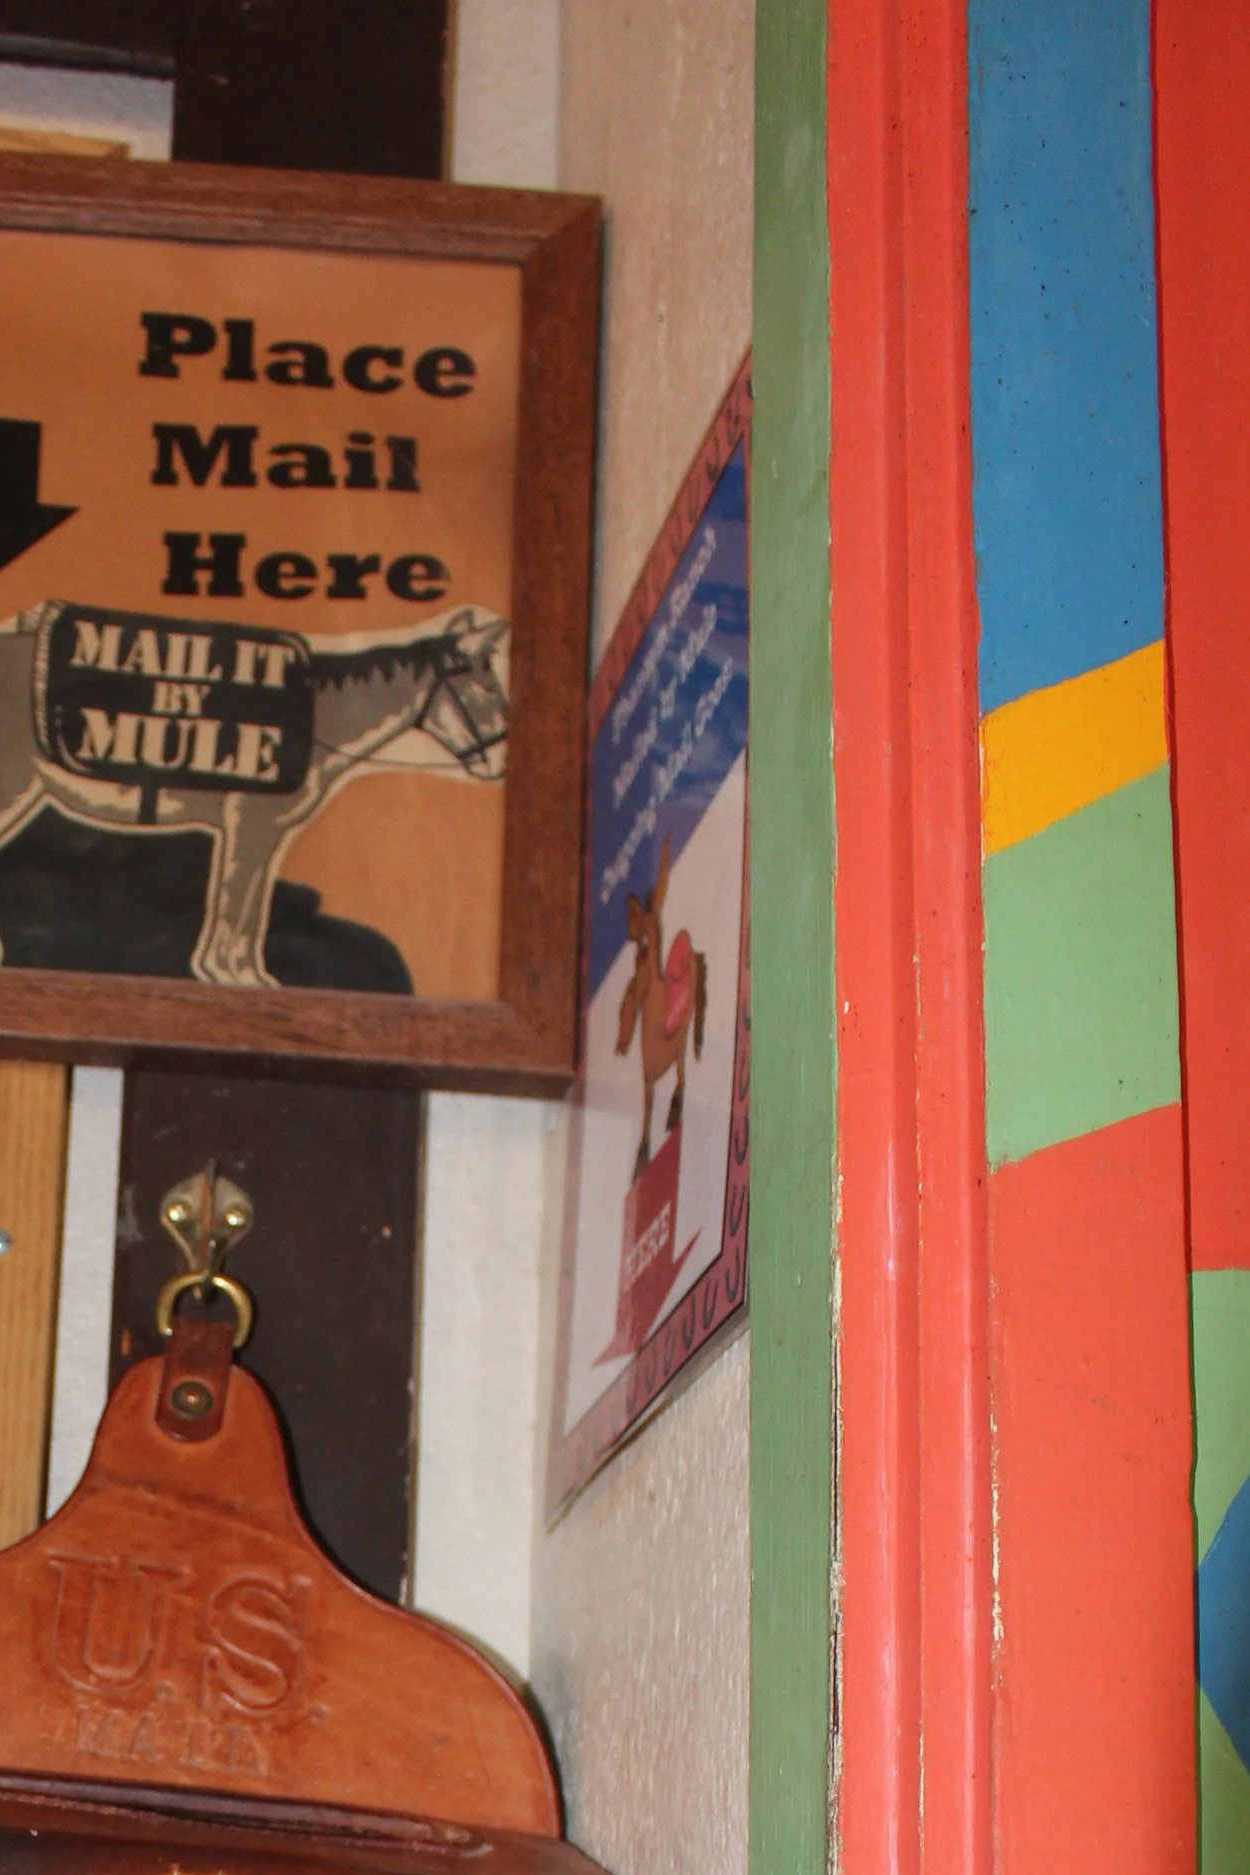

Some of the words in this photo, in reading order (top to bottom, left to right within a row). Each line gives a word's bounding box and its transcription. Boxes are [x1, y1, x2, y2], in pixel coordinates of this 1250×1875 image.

[138, 310, 478, 399] Place
[151, 423, 423, 494] Mail
[161, 530, 452, 602] Here
[69, 619, 223, 682] MAIL
[231, 638, 298, 689] IT
[151, 680, 212, 717] BY
[74, 707, 283, 784] MULE
